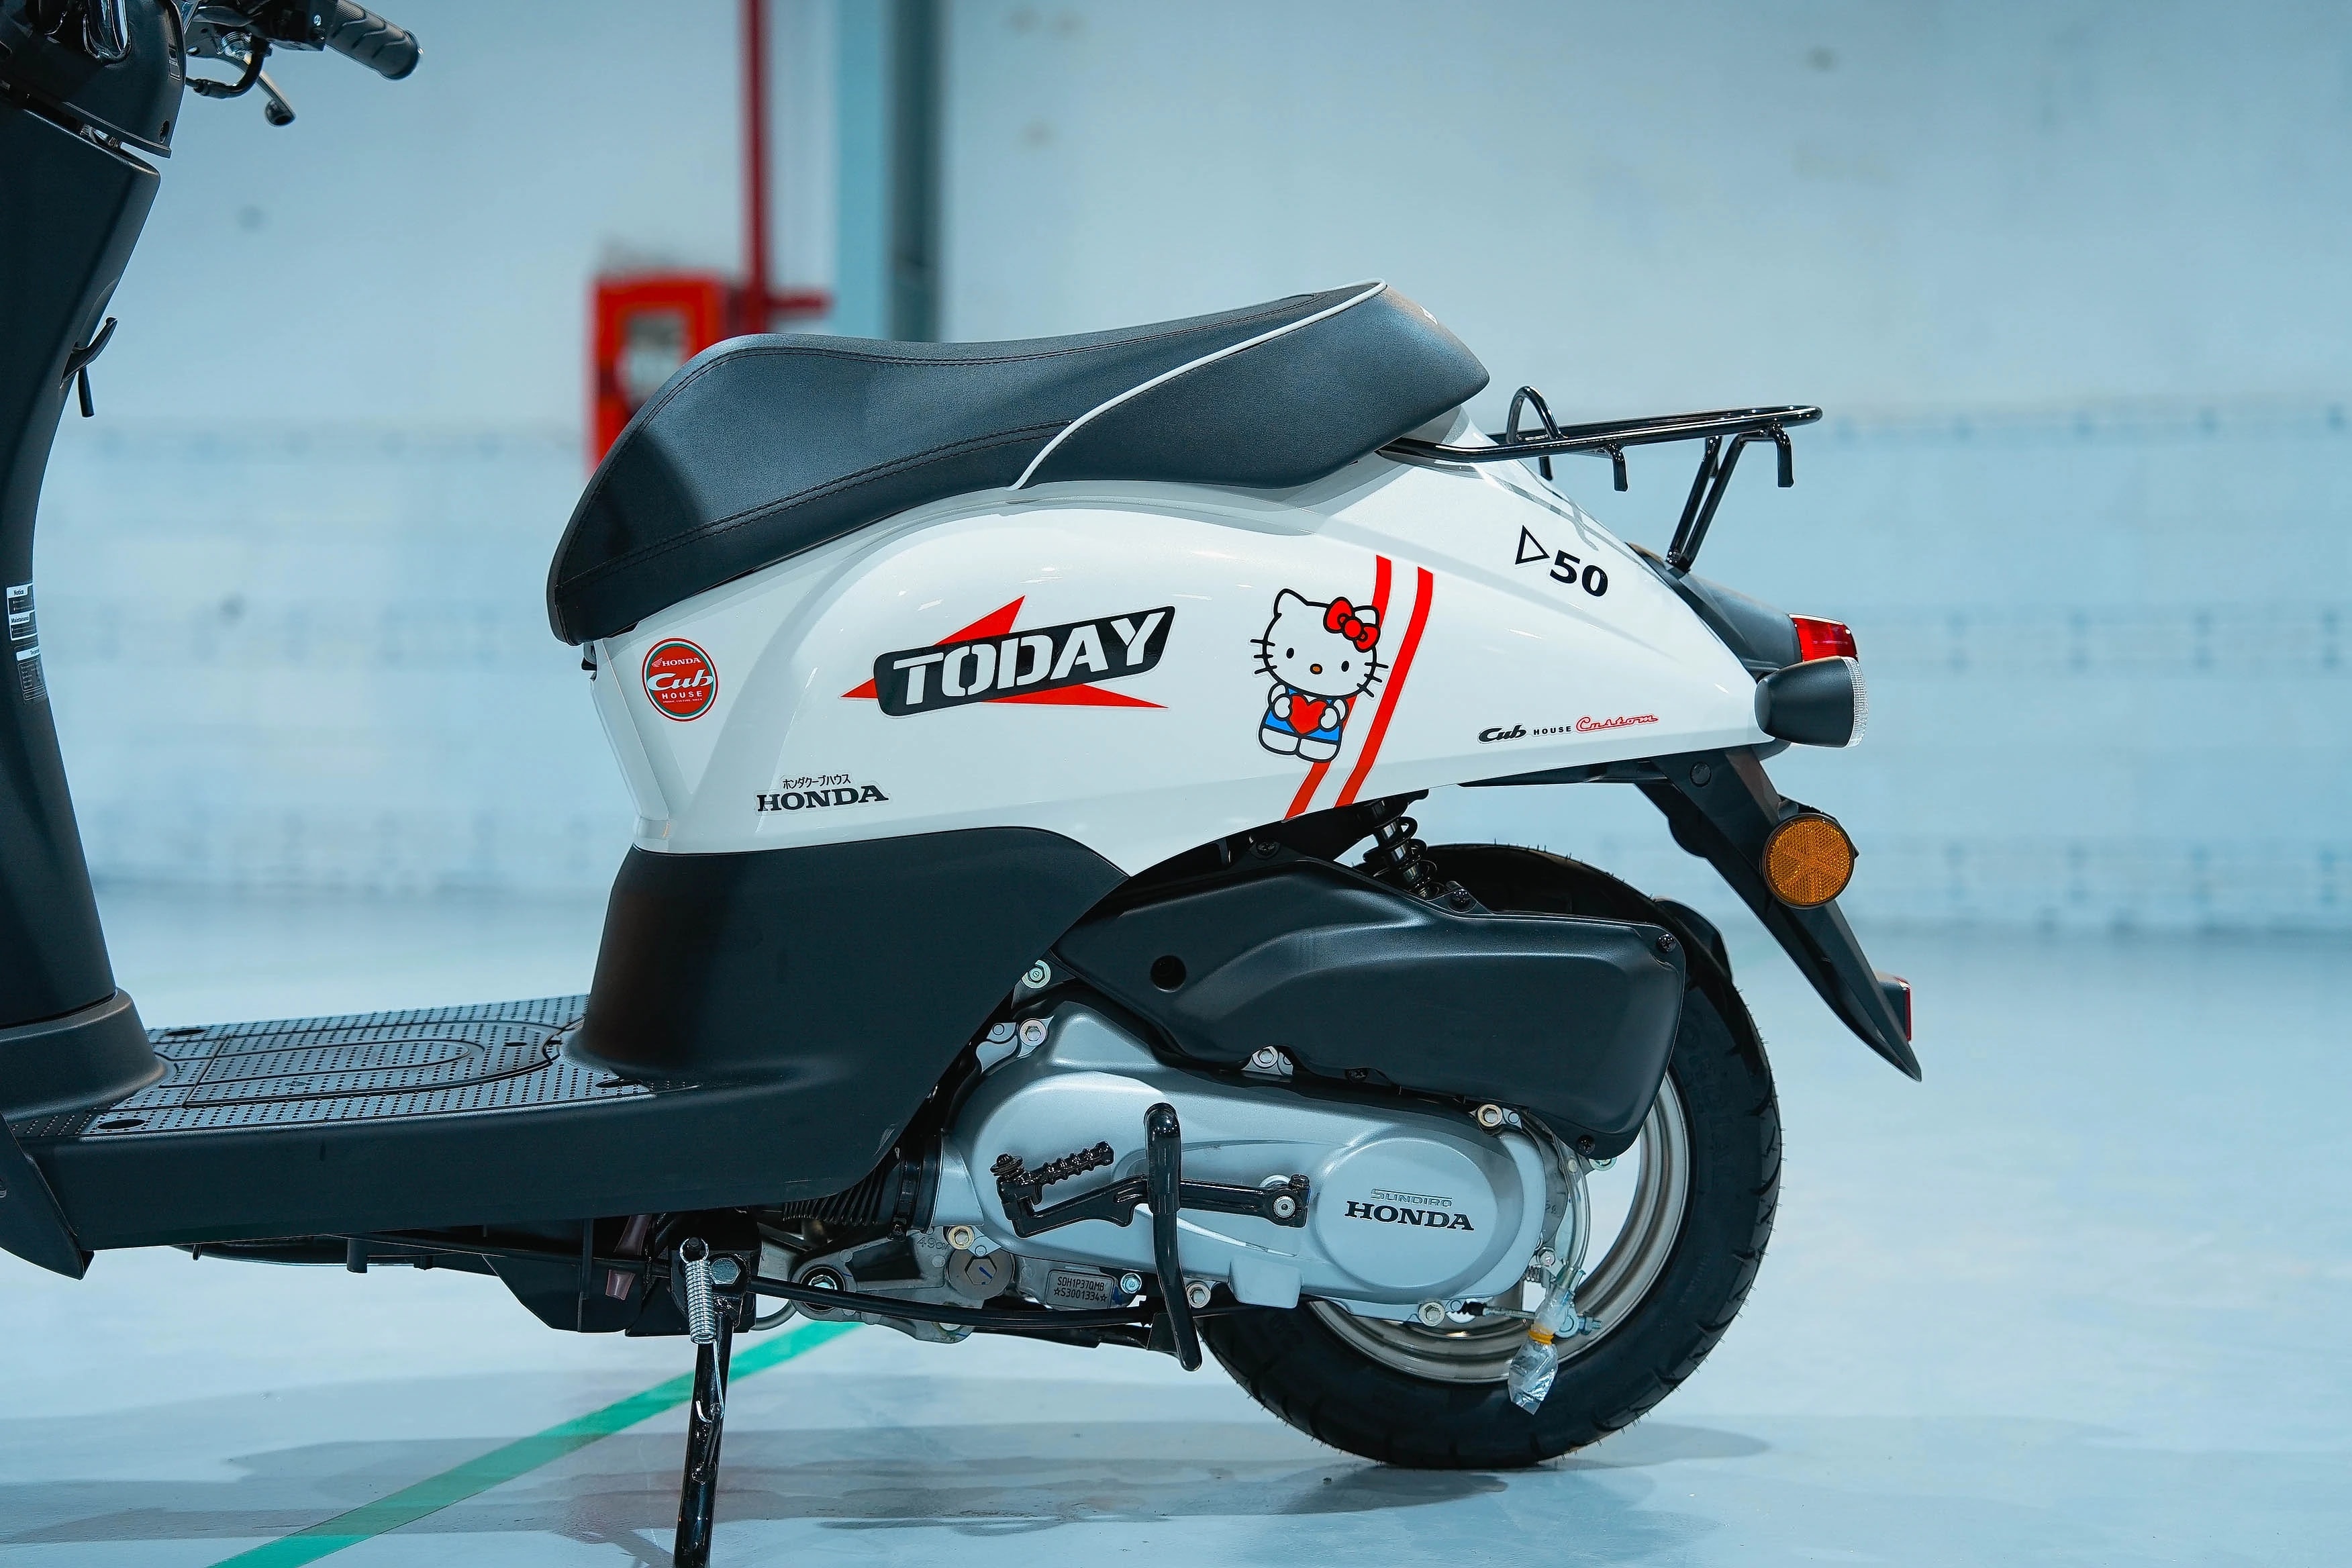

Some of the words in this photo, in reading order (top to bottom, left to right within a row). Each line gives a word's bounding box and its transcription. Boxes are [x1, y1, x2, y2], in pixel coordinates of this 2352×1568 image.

[1550, 550, 1608, 597] 50
[662, 657, 701, 667] HONDA
[893, 611, 1166, 705] TODAY
[646, 669, 714, 691] Cub
[661, 690, 703, 699] HOUSE
[1478, 724, 1527, 742] Cub
[1533, 726, 1571, 736] HOUSE
[1576, 715, 1659, 734] Custom
[756, 785, 889, 812] HONDA
[1371, 1188, 1453, 1208] SUNDIRO
[1344, 1200, 1475, 1231] HONDA
